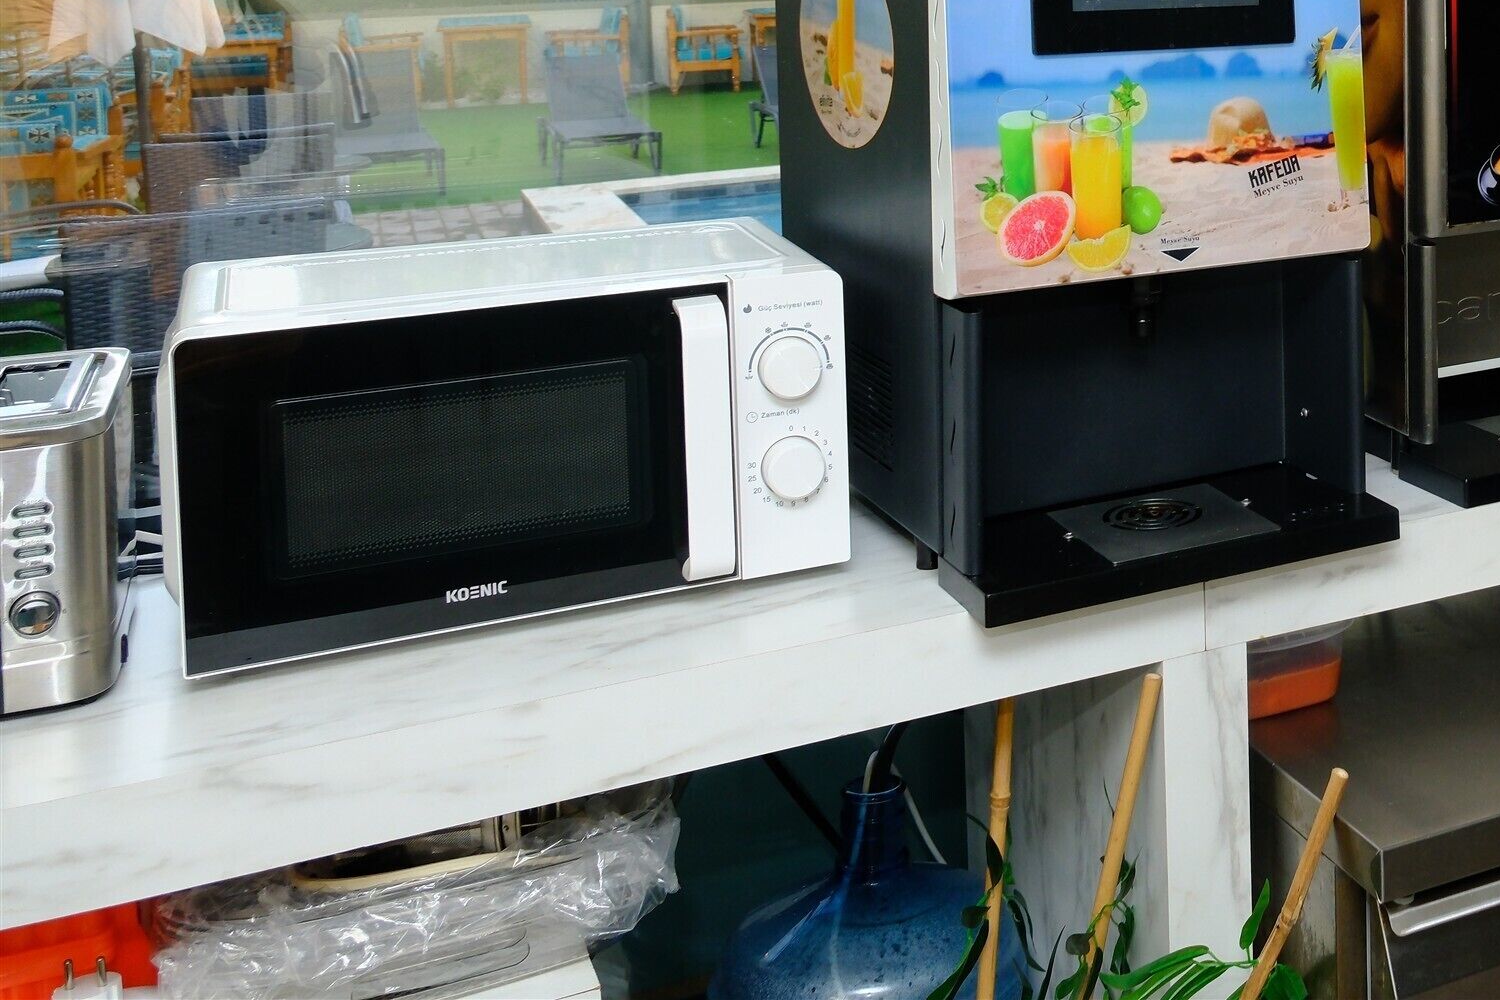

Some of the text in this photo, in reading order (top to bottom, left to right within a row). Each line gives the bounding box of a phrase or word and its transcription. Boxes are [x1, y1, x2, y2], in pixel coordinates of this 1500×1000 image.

[1248, 154, 1301, 188] KAFEDA
[1254, 175, 1304, 199] Meyve Suyu
[761, 411, 784, 419] Zaman
[446, 580, 508, 603] KOENIC
